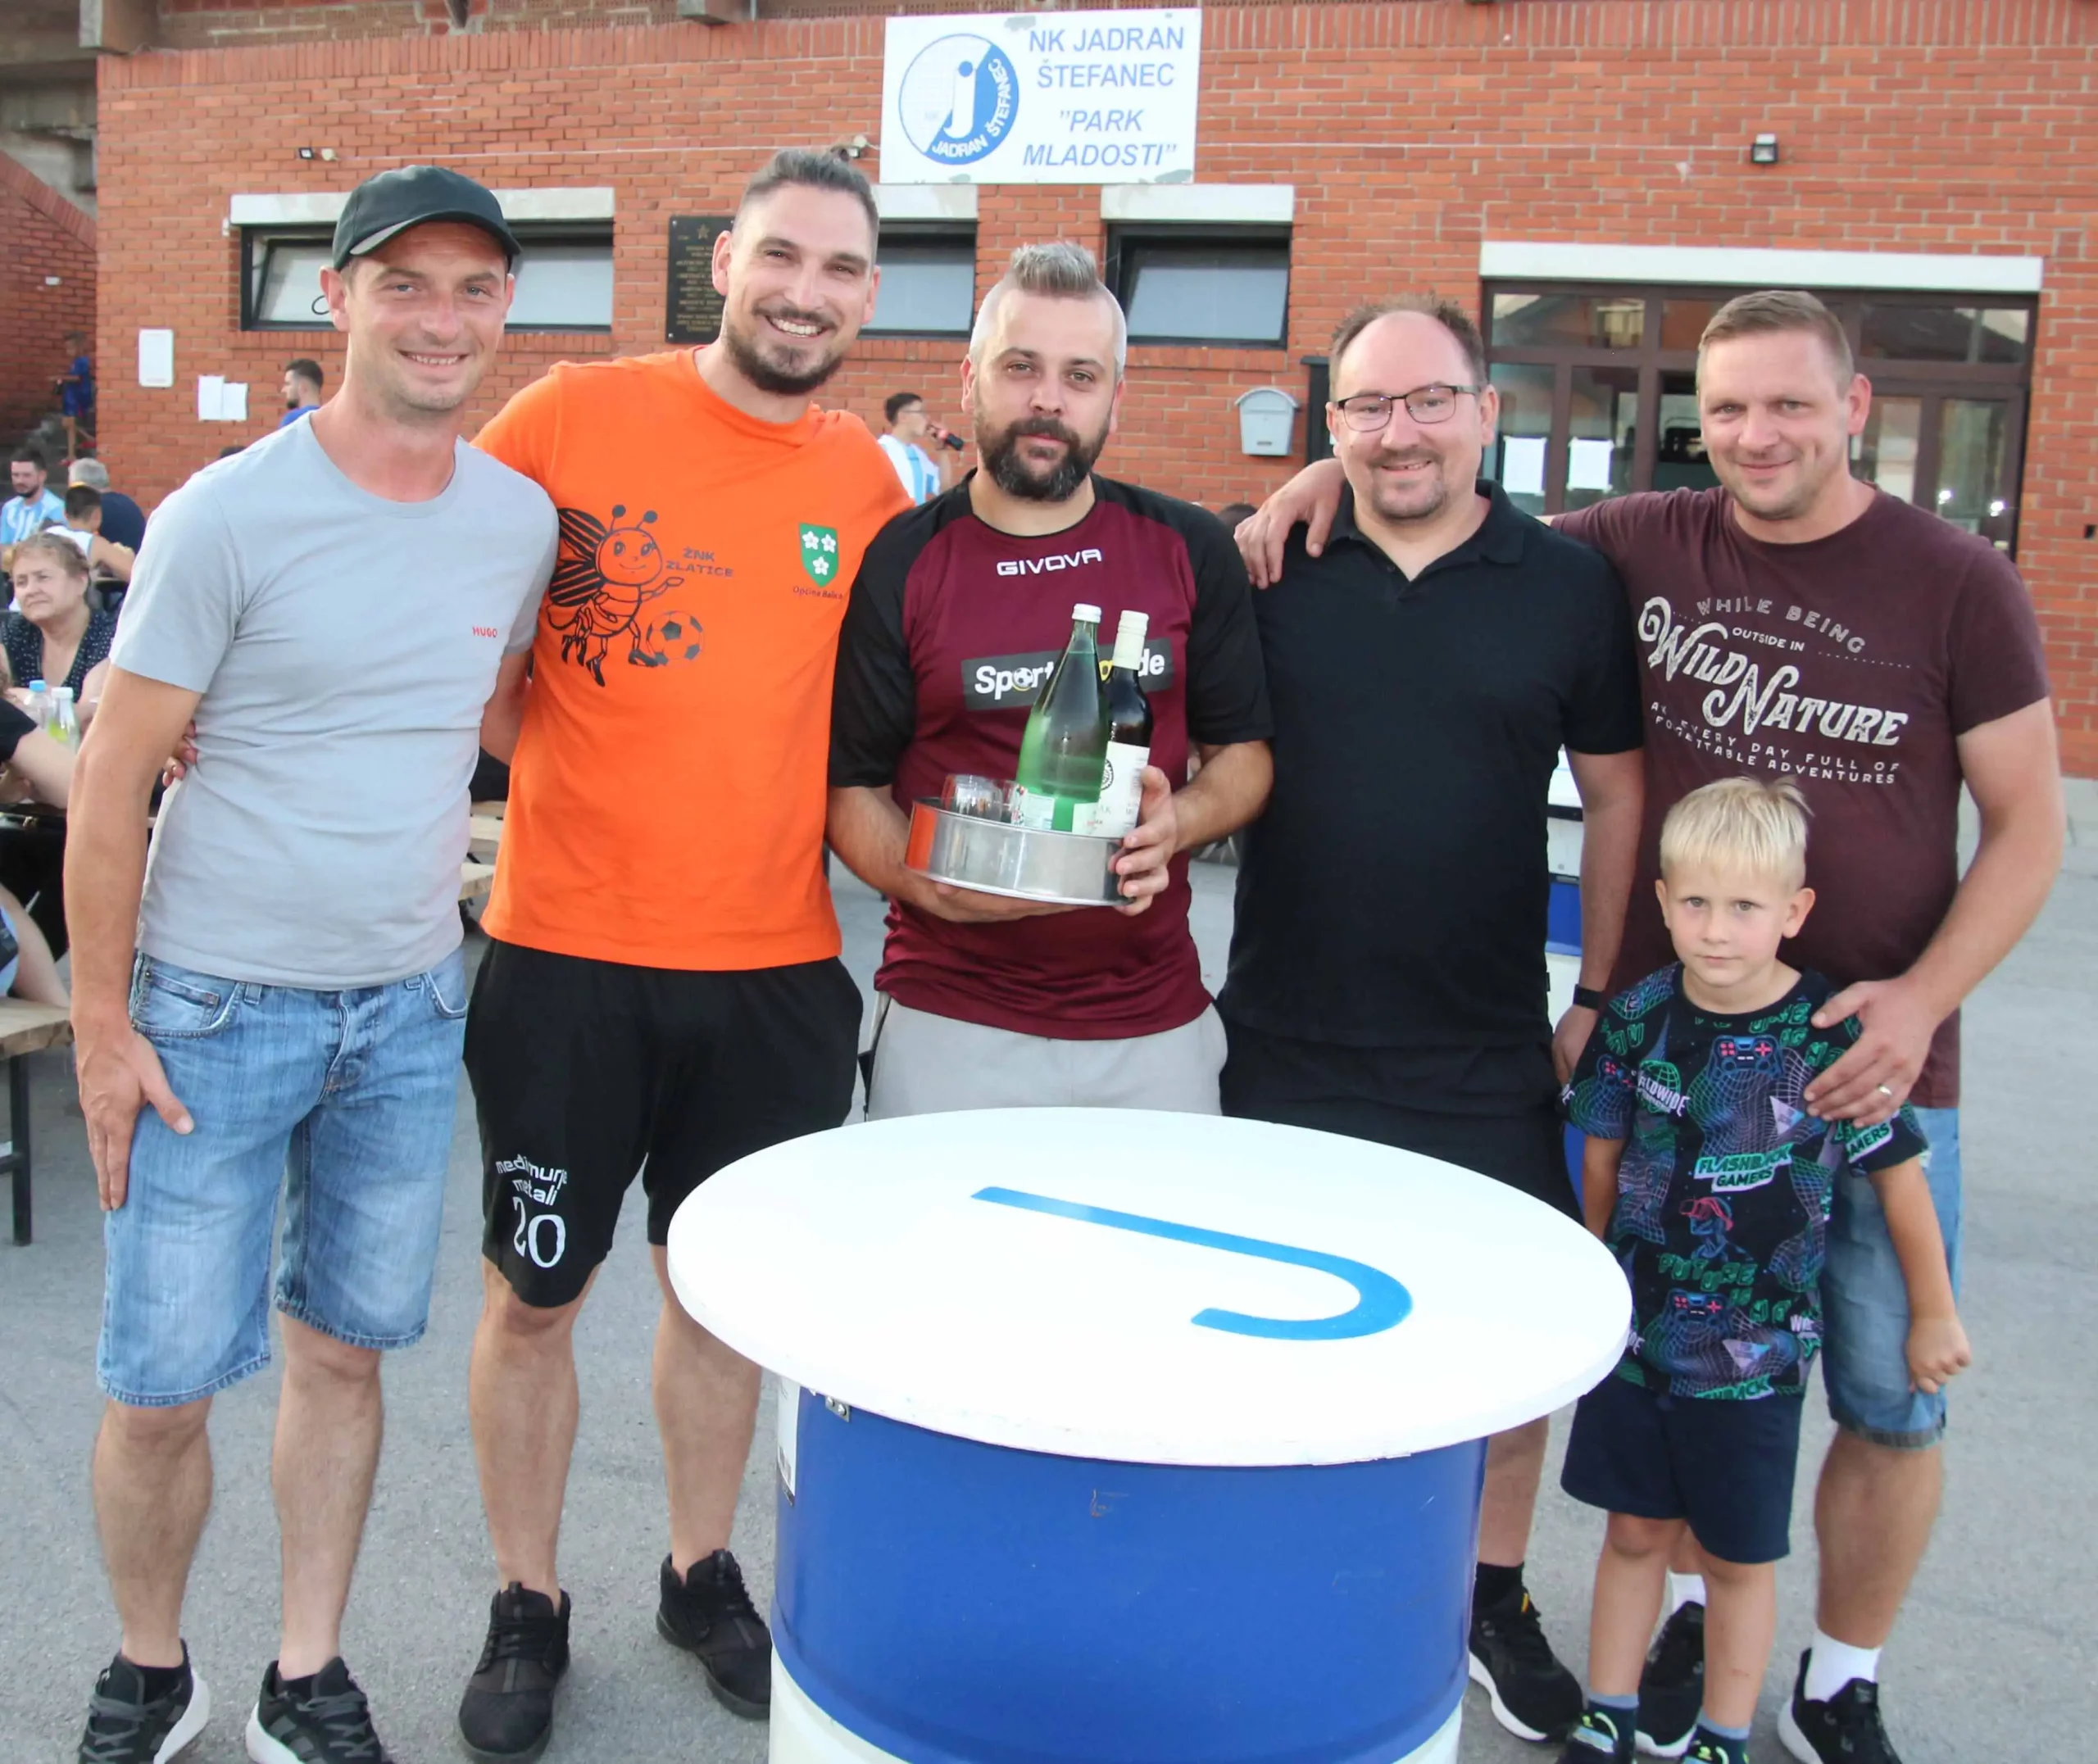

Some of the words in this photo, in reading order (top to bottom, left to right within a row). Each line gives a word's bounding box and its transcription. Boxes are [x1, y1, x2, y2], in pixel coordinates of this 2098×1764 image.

[1029, 29, 1065, 52] NK
[1074, 27, 1183, 52] JADRAN
[1038, 58, 1174, 88] ŠTEFANEC
[931, 134, 988, 157] JADRAN
[985, 58, 1011, 137] ŠTEFANEC
[666, 560, 733, 577] ZLATICE
[997, 548, 1102, 576] GIVOVA
[472, 627, 497, 637] HUGO
[1696, 596, 1773, 616] WHILE
[1786, 605, 1866, 654] BEING
[1732, 627, 1787, 649] OUTSIDE
[1790, 640, 1805, 652] IN
[1751, 742, 1789, 759] DAY
[1805, 753, 1858, 770] FULL
[1873, 761, 1900, 772] OF
[1768, 759, 1896, 784] ADVENTURES
[512, 1196, 565, 1268] 20
